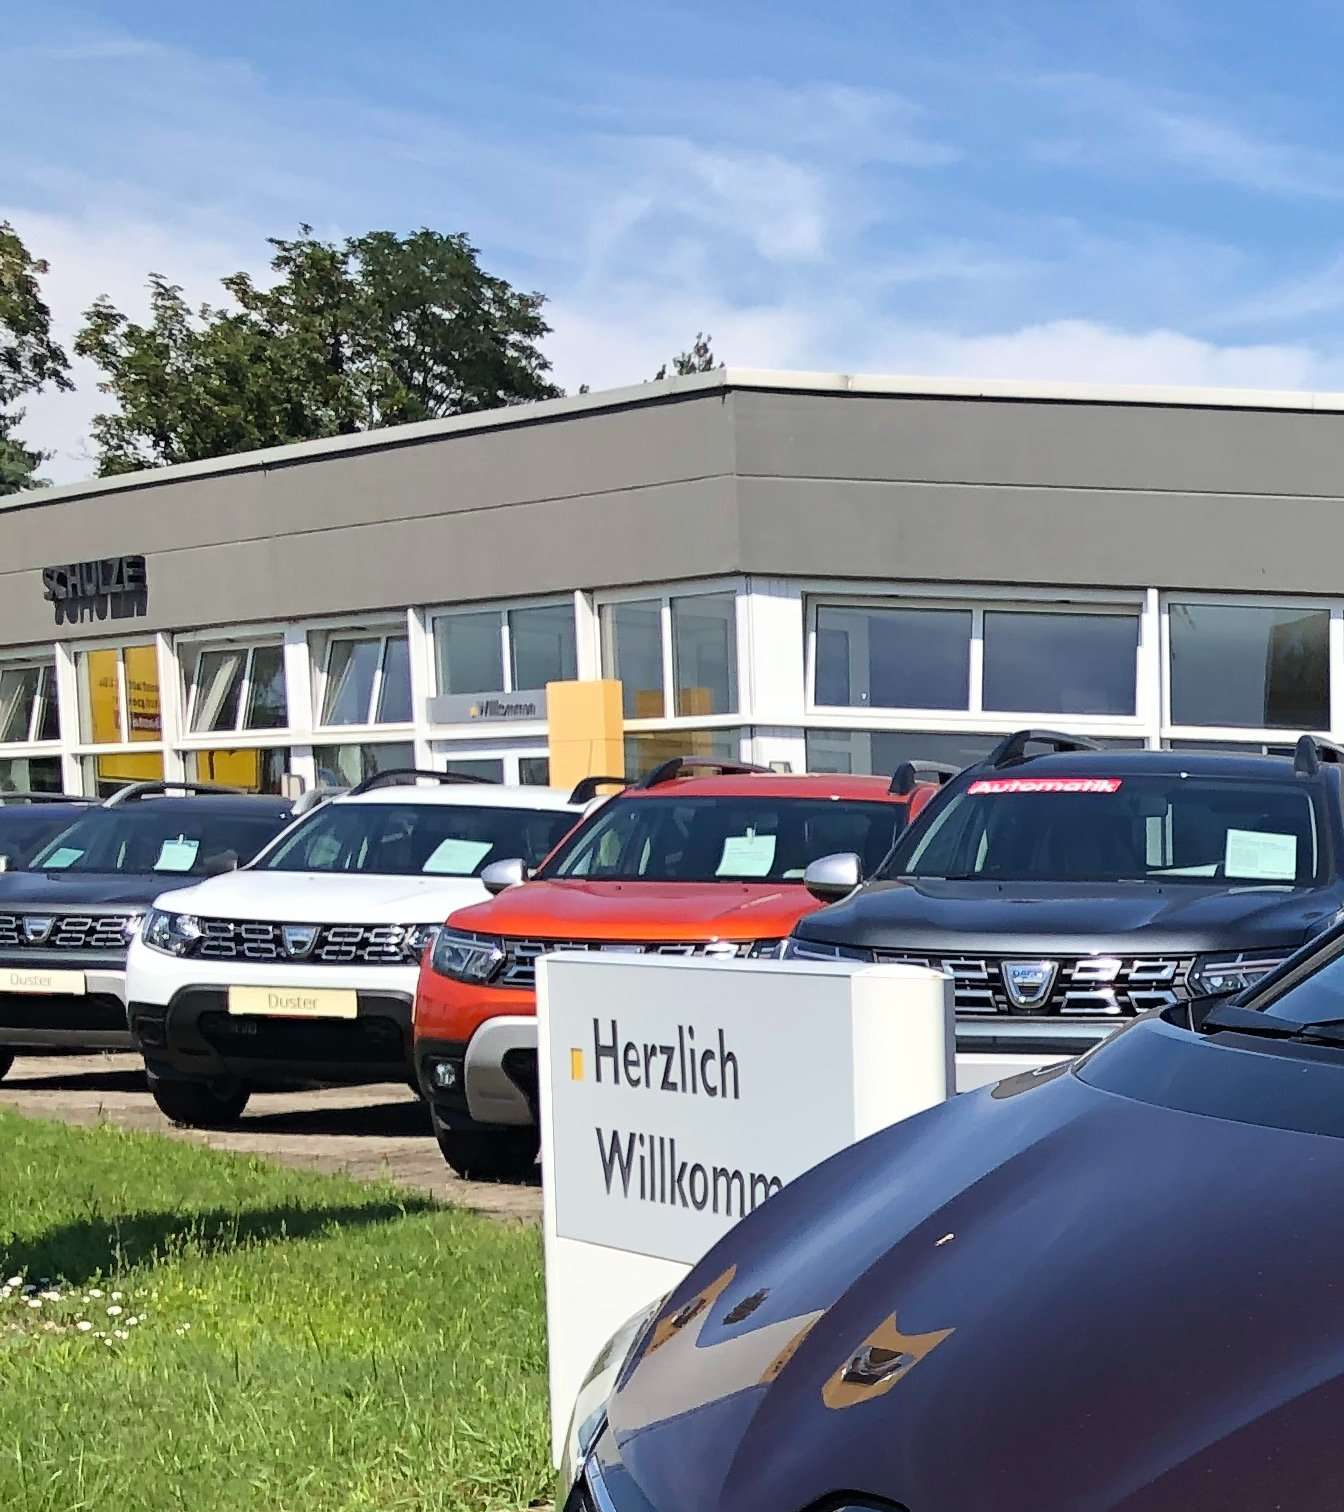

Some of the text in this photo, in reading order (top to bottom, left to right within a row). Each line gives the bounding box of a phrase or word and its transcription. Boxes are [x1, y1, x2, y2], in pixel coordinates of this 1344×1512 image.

[43, 556, 146, 600] SCHULZE
[974, 780, 1115, 793] Automatik
[267, 993, 319, 1010] Duster
[593, 1018, 740, 1100] Herzlich
